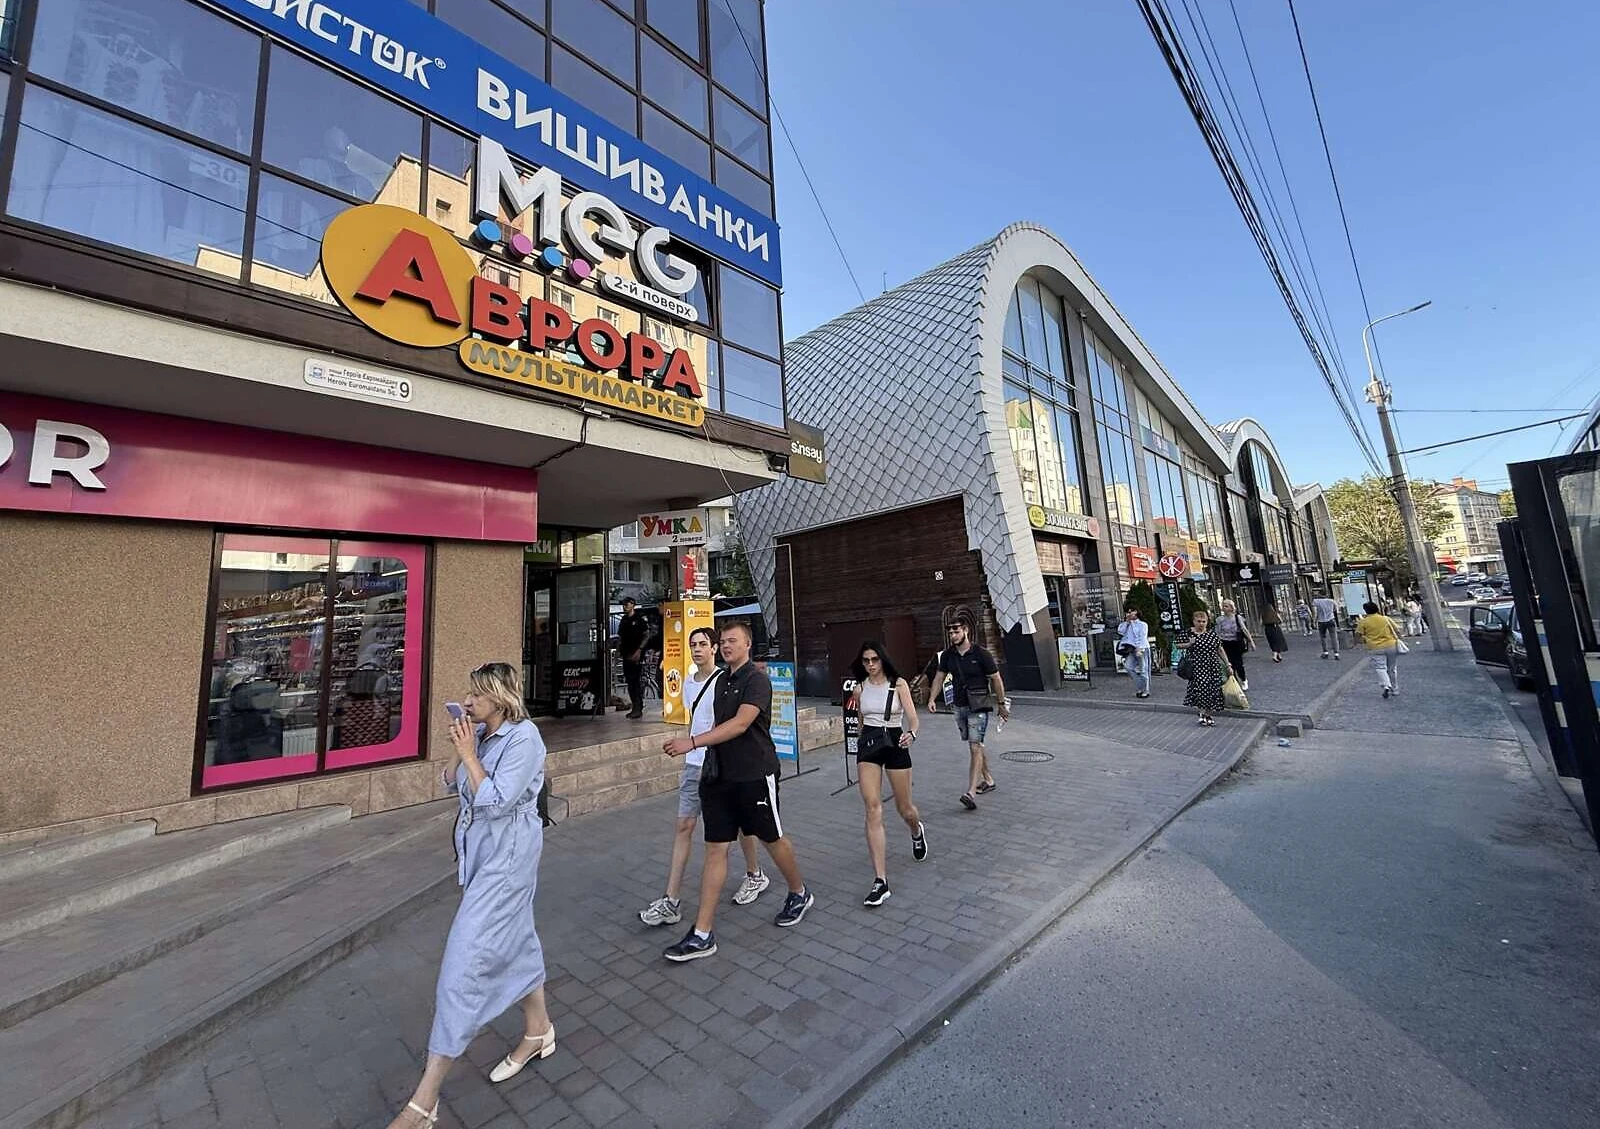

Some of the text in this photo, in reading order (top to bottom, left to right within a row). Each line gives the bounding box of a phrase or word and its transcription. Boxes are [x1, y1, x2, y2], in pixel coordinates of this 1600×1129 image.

[477, 67, 769, 262] ВИШИВАНКИ
[352, 227, 703, 398] АВРОРА
[614, 276, 692, 317] 2-й поверх
[400, 381, 410, 399] 9
[469, 342, 701, 422] МУЛЬТИМАРКЕТ
[0, 418, 110, 489] R
[791, 440, 823, 464] sinsay
[640, 515, 704, 538] УМКА
[672, 534, 679, 543] 2
